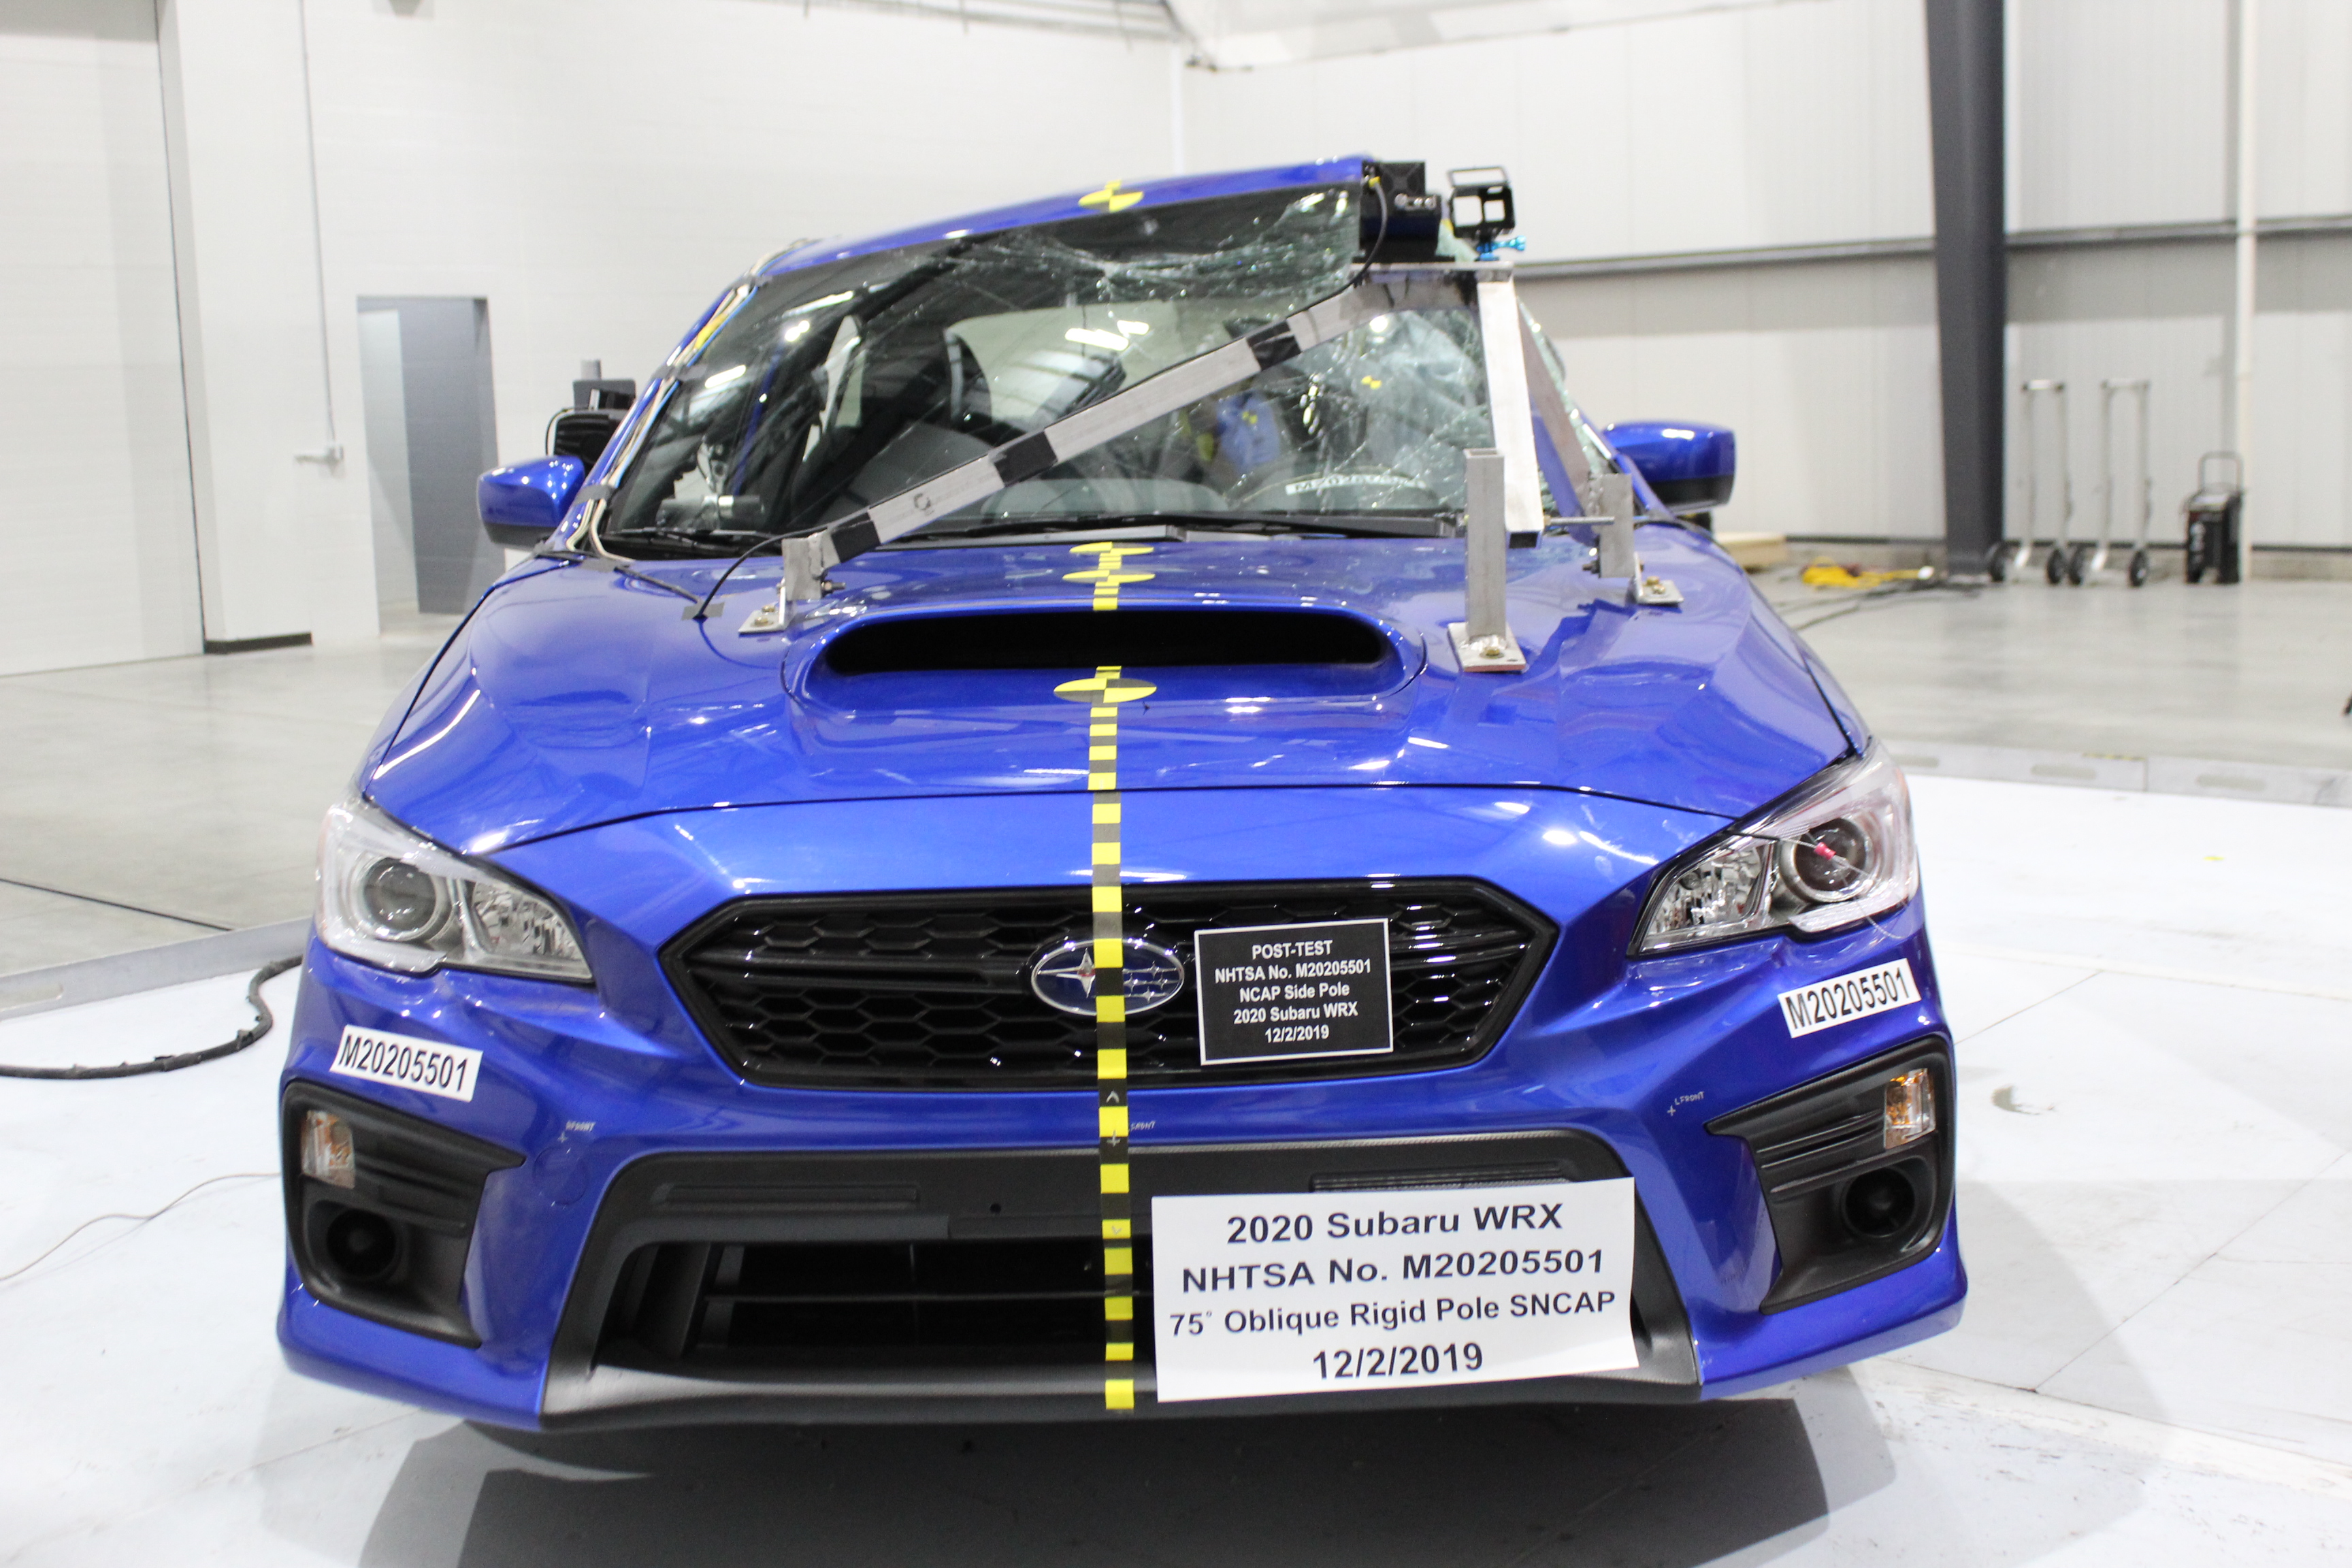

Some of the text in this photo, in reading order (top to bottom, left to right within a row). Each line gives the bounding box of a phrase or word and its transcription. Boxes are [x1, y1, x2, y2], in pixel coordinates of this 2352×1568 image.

[1252, 939, 1333, 960] POST-TEST
[1214, 958, 1371, 984] NHTSA No. M20205501
[1239, 981, 1350, 1003] NCAP Side Pole
[1785, 966, 1910, 1030] M20205501
[1232, 1000, 1359, 1025] 2020 Subaru WRX
[1264, 1024, 1330, 1044] 12/2/2019
[338, 1034, 468, 1092] M20205501
[1227, 1203, 1563, 1244] 2020 Subaru WRX
[1183, 1249, 1603, 1293] NHTSA No. M20205501
[1224, 1307, 1340, 1337] Oblique
[1350, 1301, 1427, 1332] Rigid
[1435, 1296, 1501, 1322] Pole
[1509, 1290, 1616, 1318] SNCAP
[1313, 1342, 1484, 1379] 12/2/2019
